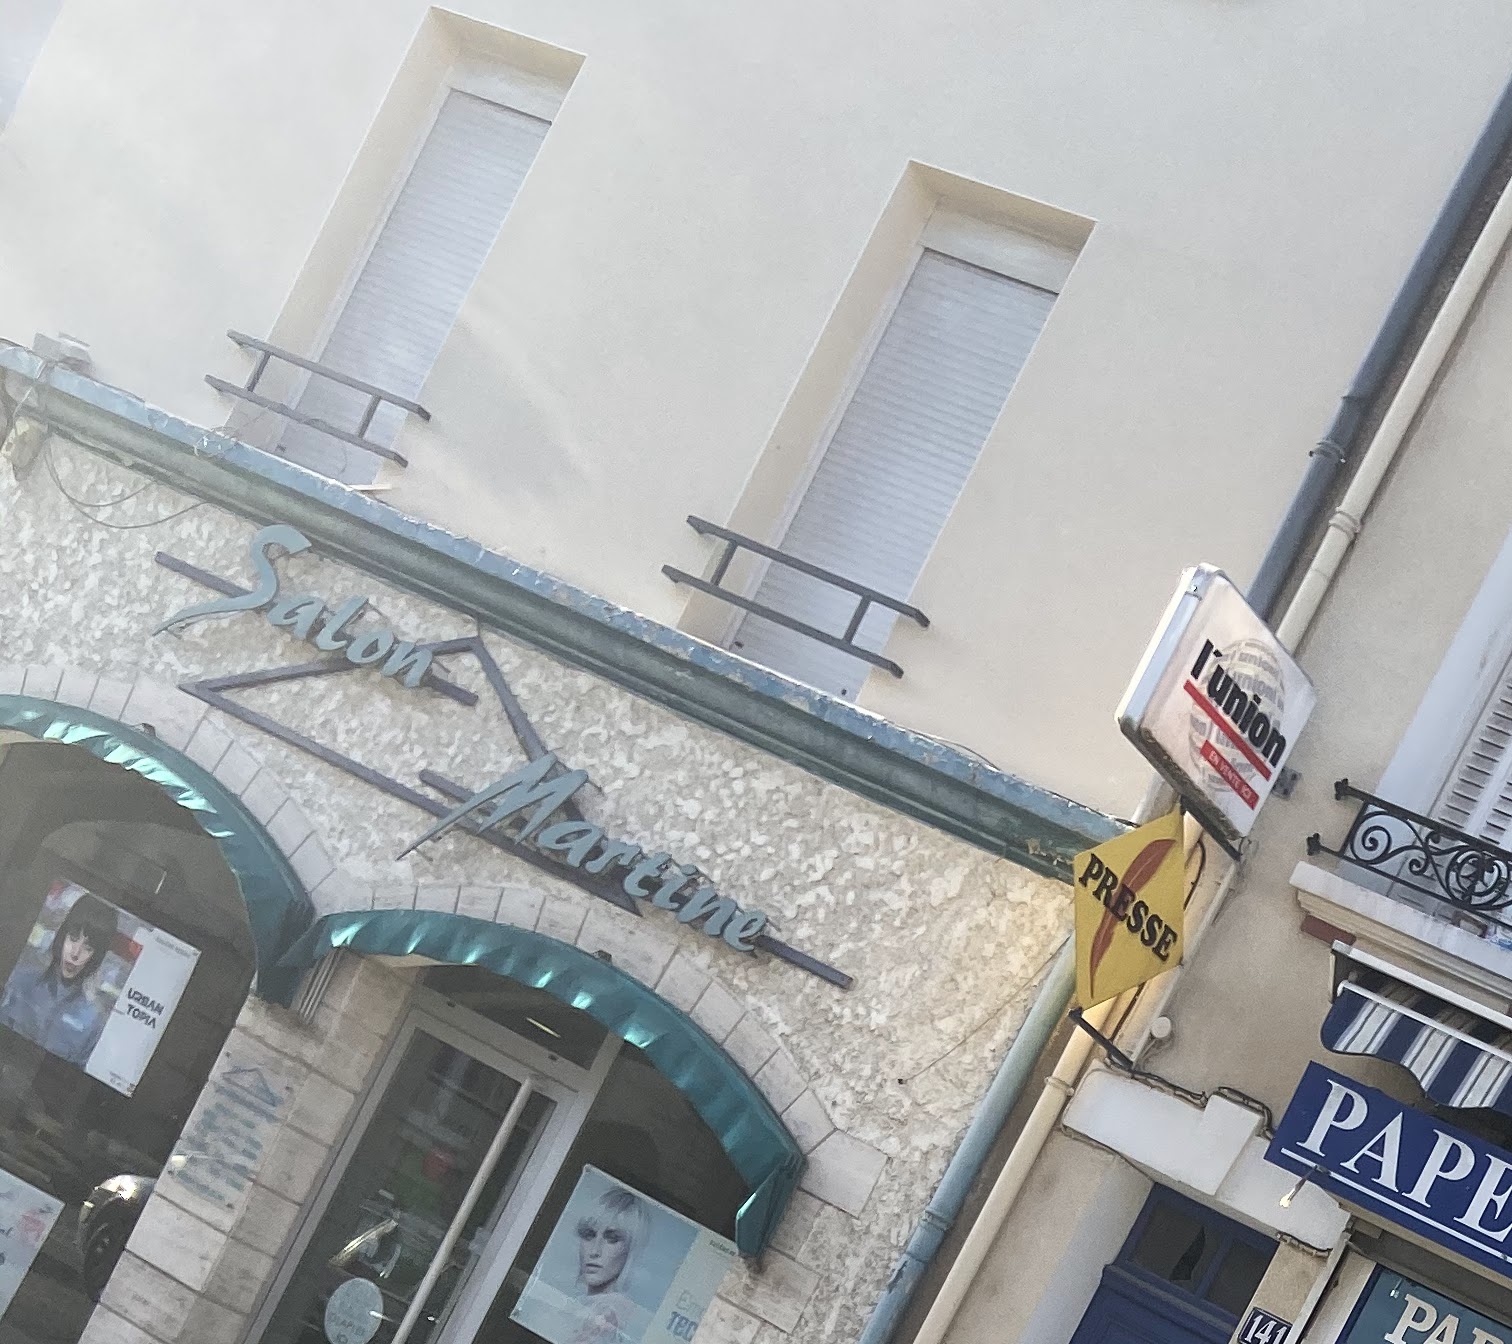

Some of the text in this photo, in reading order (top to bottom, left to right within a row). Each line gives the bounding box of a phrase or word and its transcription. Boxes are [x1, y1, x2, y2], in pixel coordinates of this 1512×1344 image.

[151, 524, 437, 689] Salon
[1191, 638, 1287, 768] l'union
[1220, 760, 1241, 788] VENTE
[397, 751, 773, 955] Martine
[1078, 853, 1179, 962] PRESSE
[125, 1003, 157, 1029] TOPIA
[127, 987, 165, 1016] URBAN
